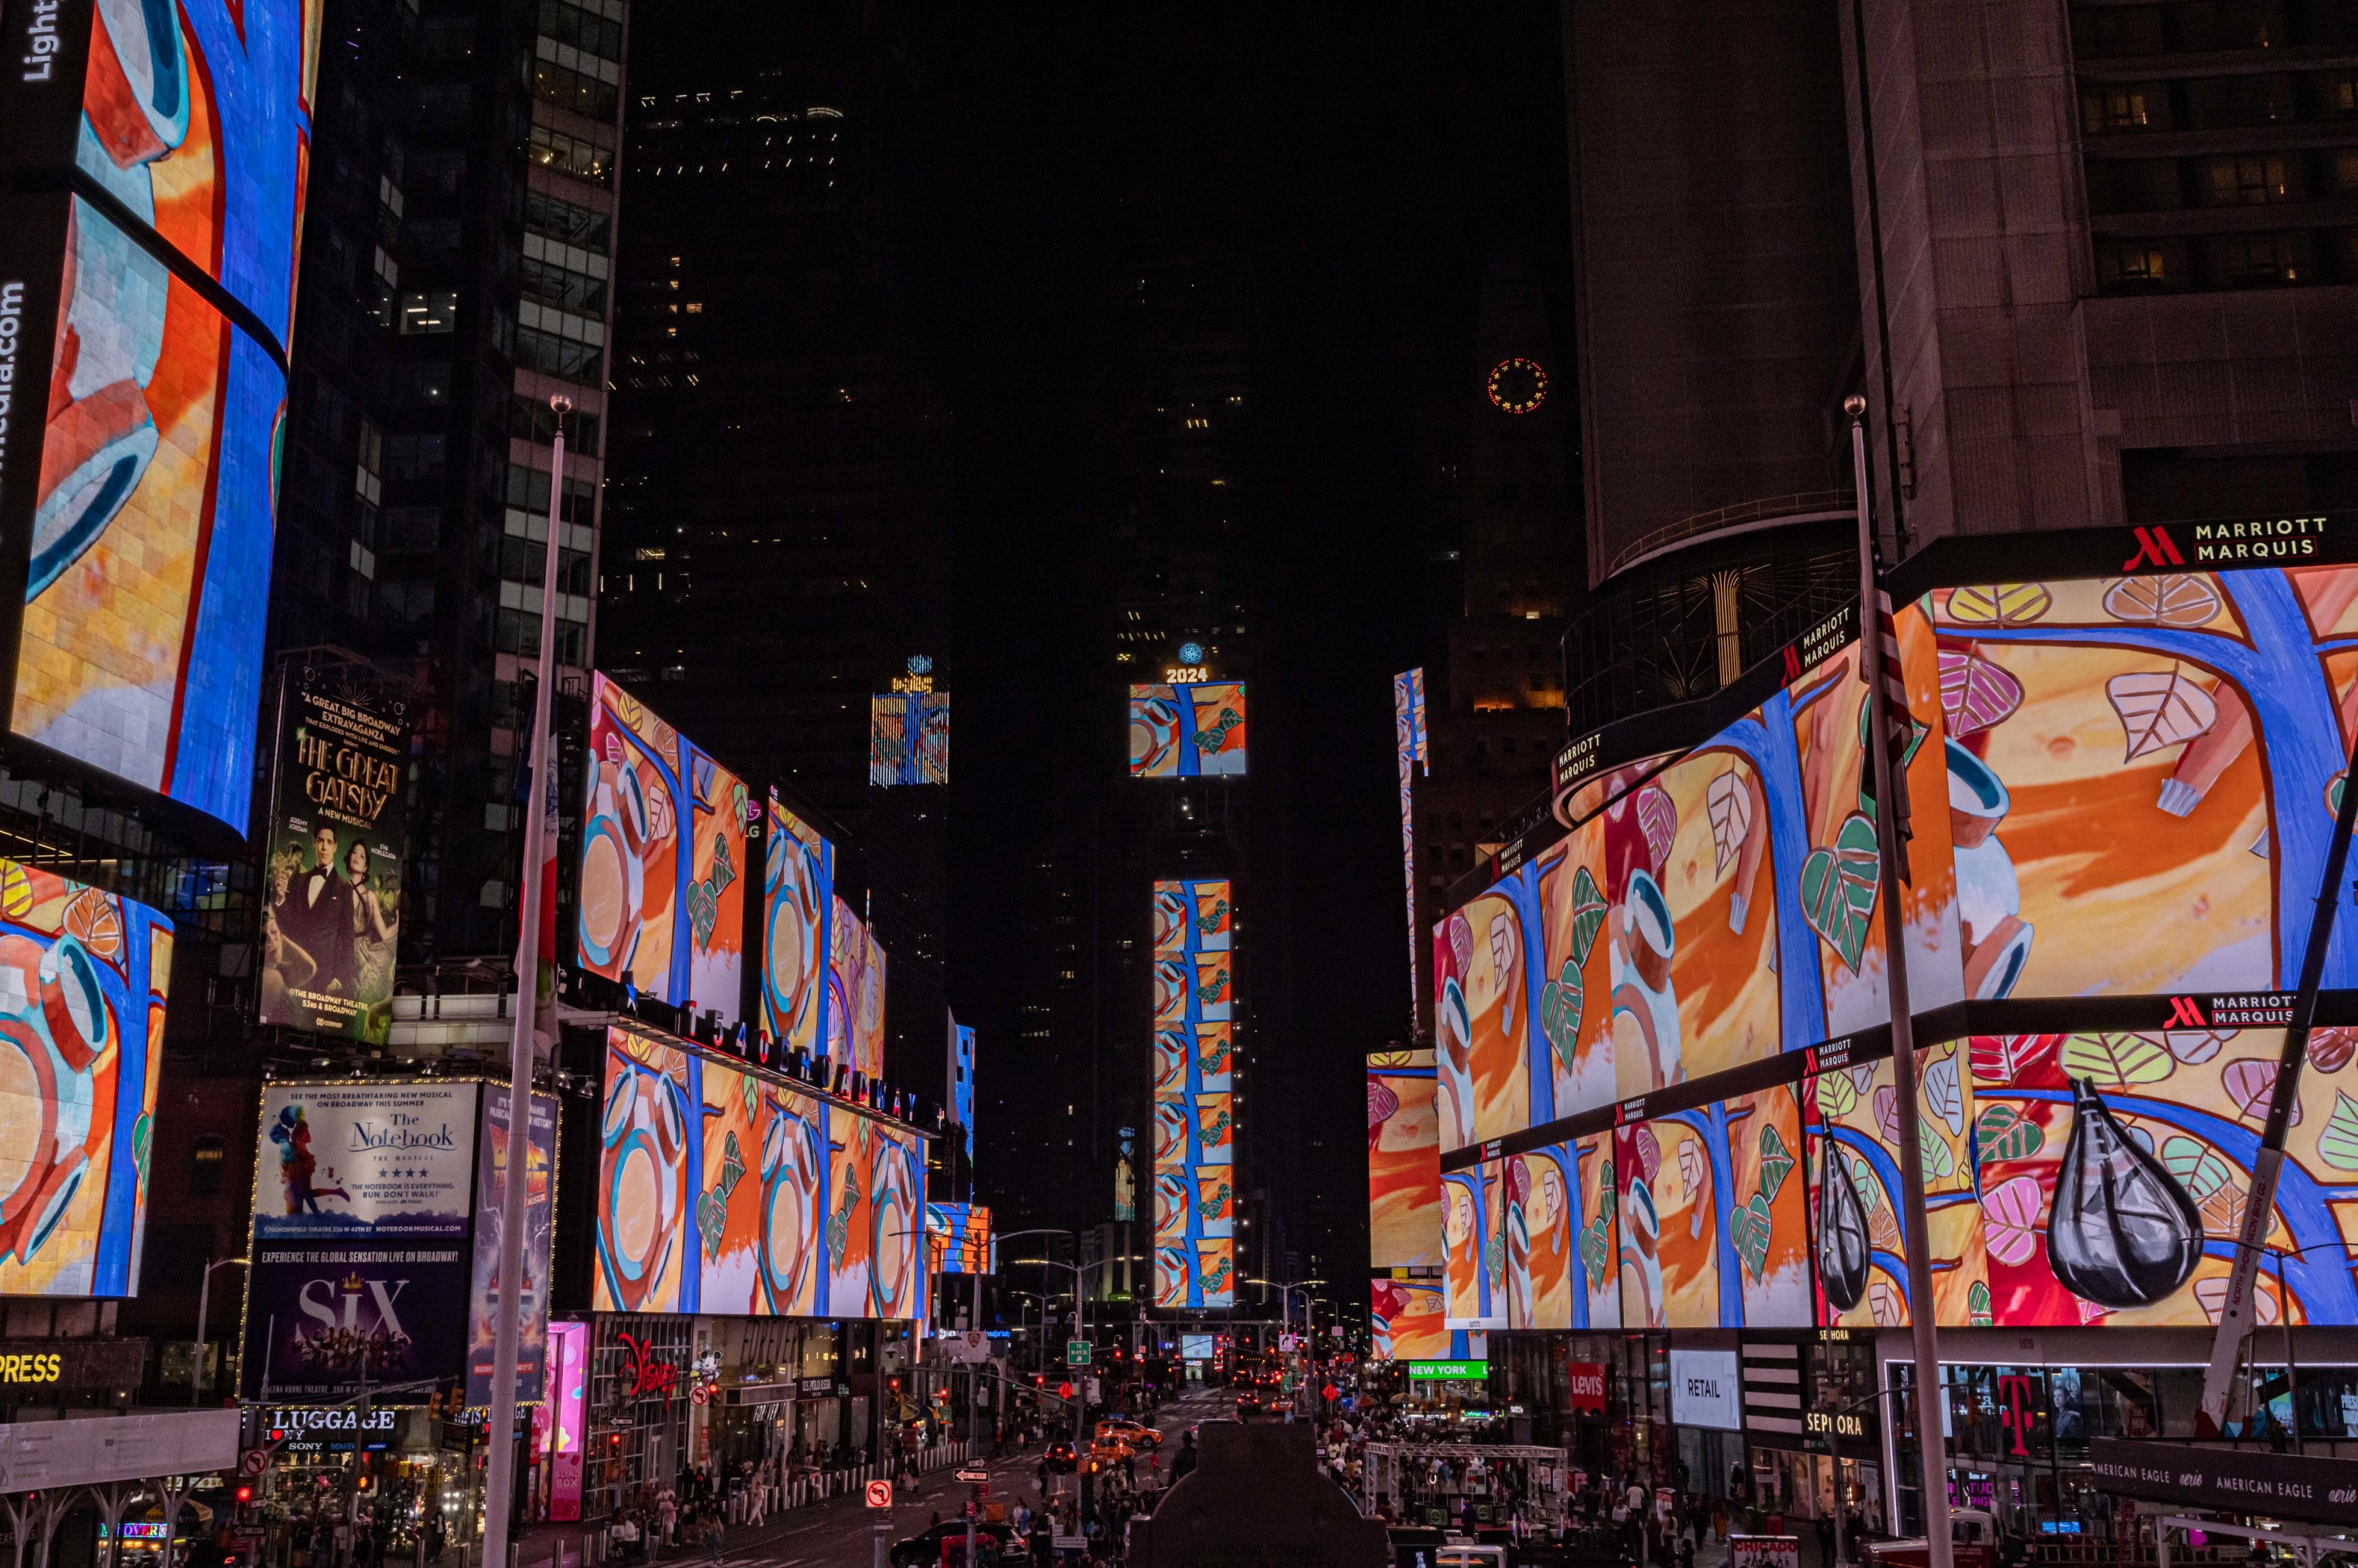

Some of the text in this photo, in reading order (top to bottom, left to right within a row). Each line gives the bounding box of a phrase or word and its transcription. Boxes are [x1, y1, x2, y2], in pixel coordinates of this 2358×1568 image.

[2196, 518, 2327, 539] MARRIOTT
[2198, 539, 2314, 561] MARQUIS
[1804, 607, 1850, 649] MARRIOTT
[1805, 630, 1845, 668] MARQUIS
[1166, 668, 1208, 683] 2024
[322, 710, 385, 742] EXTRAVAGANZA
[341, 705, 356, 719] BIG
[357, 712, 401, 735] BROADWAY
[305, 716, 318, 727] THAT
[318, 721, 345, 736] EXPLODES
[345, 731, 358, 740] WITH
[358, 734, 368, 744] LIFE
[368, 738, 379, 748] AND
[1559, 734, 1600, 768] MARRIOTT
[298, 733, 401, 794] THE GREAT
[1560, 755, 1595, 785] MARQUIS
[306, 771, 388, 821] GATSBY
[289, 816, 308, 826] JEREMY
[318, 807, 371, 830] A NEW MUSICAL
[288, 824, 308, 833] JORDAN
[371, 847, 396, 859] NOBLEZADA
[1501, 839, 1523, 861] MARRIOTT
[1501, 853, 1522, 874] MARQUIS
[294, 989, 368, 1011] THE BROADWAY THEATRE
[2213, 995, 2296, 1009] MARRIOT
[324, 1004, 357, 1016] BROADWAY
[2215, 1010, 2293, 1022] MARQUIS
[689, 1000, 769, 1064] 1540
[1819, 1039, 1851, 1056] MARRIOTT
[1820, 1053, 1848, 1068] MARQUIS
[530, 1105, 546, 1116] HANGE
[1624, 1098, 1645, 1110] MARRIOTT
[390, 1113, 419, 1126] The
[1624, 1109, 1643, 1121] MARQUIS
[533, 1119, 553, 1129] HISTORY
[350, 1121, 454, 1147] Notebook
[1486, 1140, 1501, 1149] MARRIOTT
[1487, 1149, 1500, 1158] MARQUIS
[262, 1250, 458, 1263] EXPERIENCE THE GLOBAL SENSATION LIVE ON BROADWAY!
[2233, 1275, 2245, 1306] NORTH
[2246, 1218, 2258, 1244] NEON
[2252, 1197, 2263, 1218] SIGN
[298, 1279, 410, 1335] SIX
[1819, 1329, 1849, 1340] SEHORA
[1410, 1365, 1435, 1375] NEW
[1437, 1365, 1466, 1375] YORK
[304, 1385, 329, 1393] THEATRE
[810, 1379, 819, 1391] POLO
[1687, 1378, 1721, 1399] RETAIL
[273, 1410, 395, 1429] LUGGAGE
[1807, 1413, 1862, 1435] SEPORA
[288, 1442, 323, 1451] SONY
[557, 1479, 578, 1487] BOX
[2092, 1463, 2357, 1504] AMERICAN EAGLE aerie AMERICAN EAGLE aerie
[1734, 1541, 1798, 1552] CHICAGO
